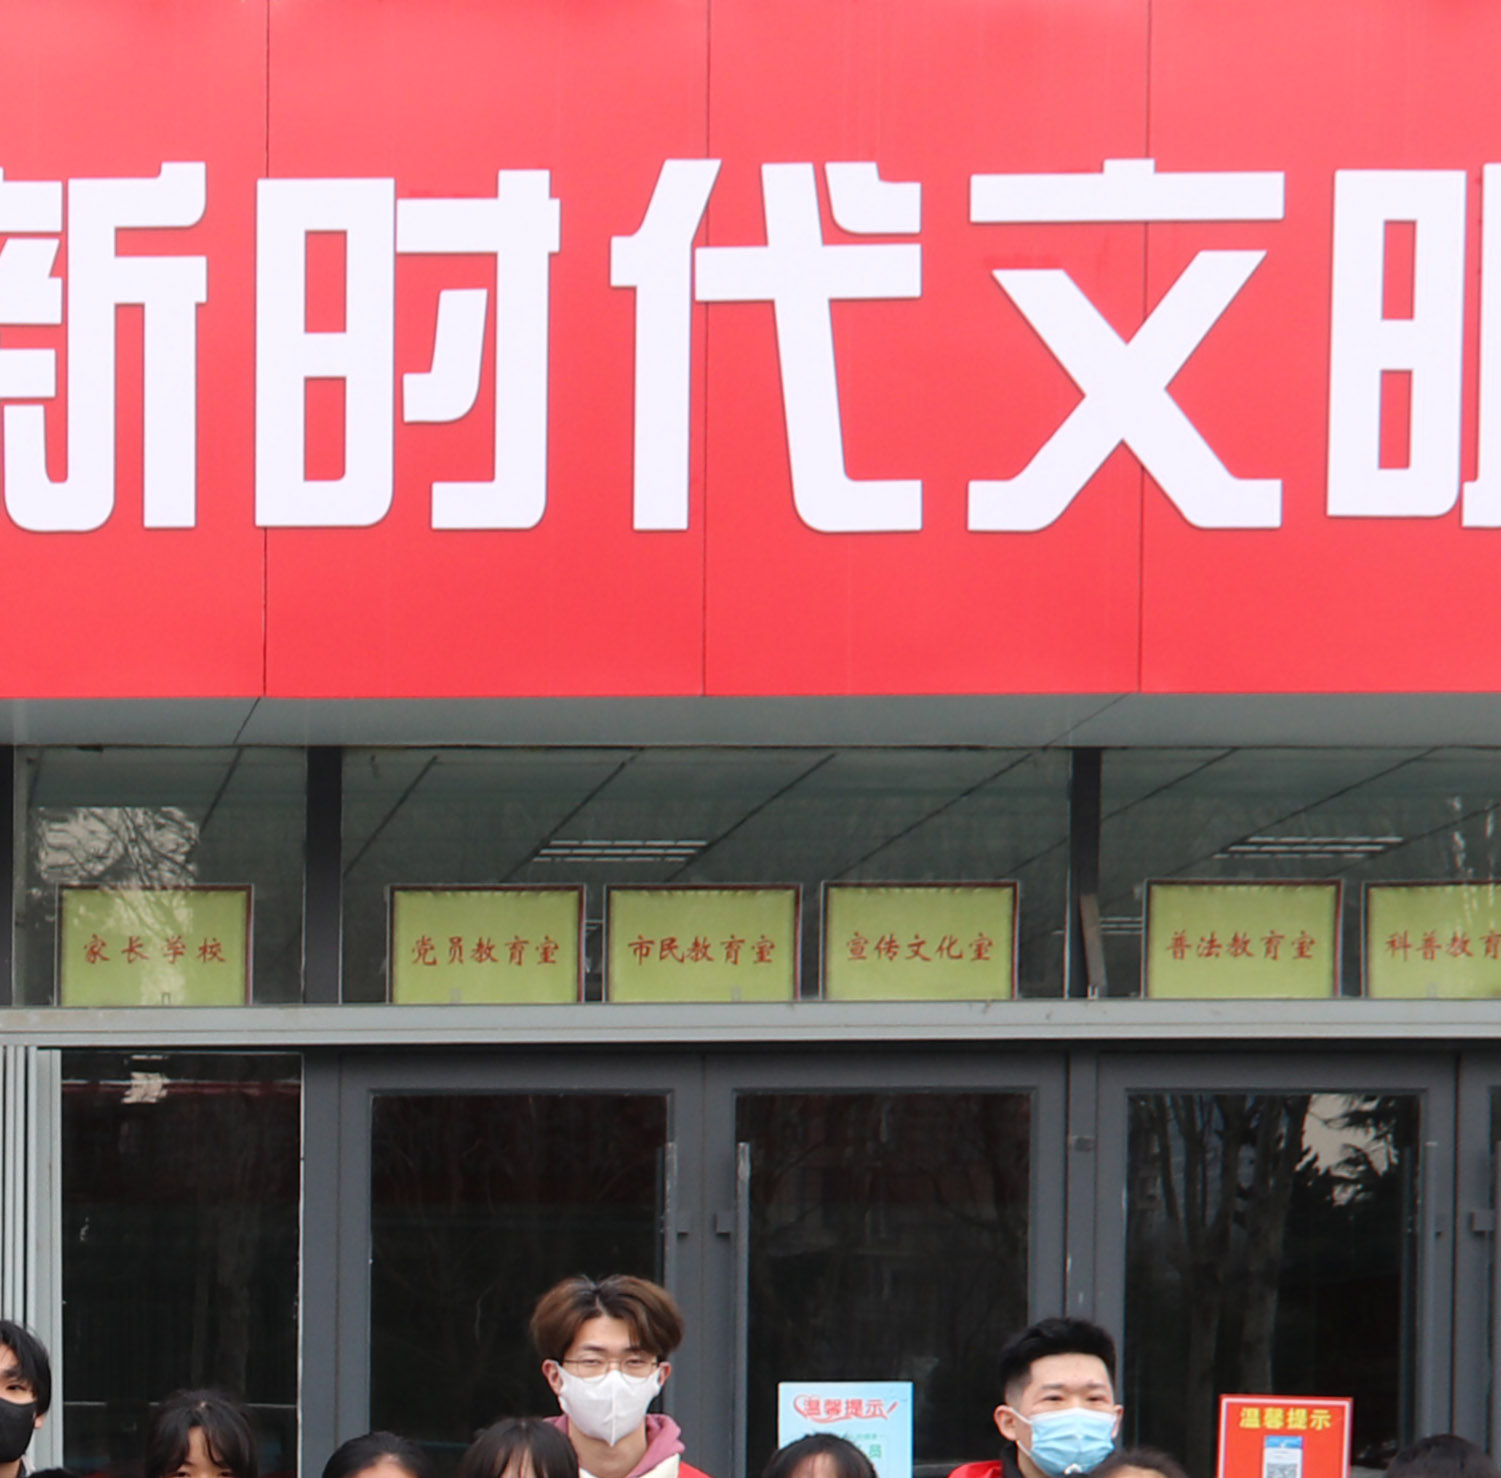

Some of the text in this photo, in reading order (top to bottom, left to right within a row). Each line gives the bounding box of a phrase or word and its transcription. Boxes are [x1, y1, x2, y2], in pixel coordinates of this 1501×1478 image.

[84, 933, 227, 965] 家长学校
[411, 935, 561, 966] 党员教育室
[628, 933, 777, 966] 市民教育室
[847, 931, 994, 962] 宣传文化室
[1166, 928, 1317, 960] 普法教育室
[804, 1398, 884, 1418] 温馨提示
[1240, 1407, 1332, 1431] 温馨提示
